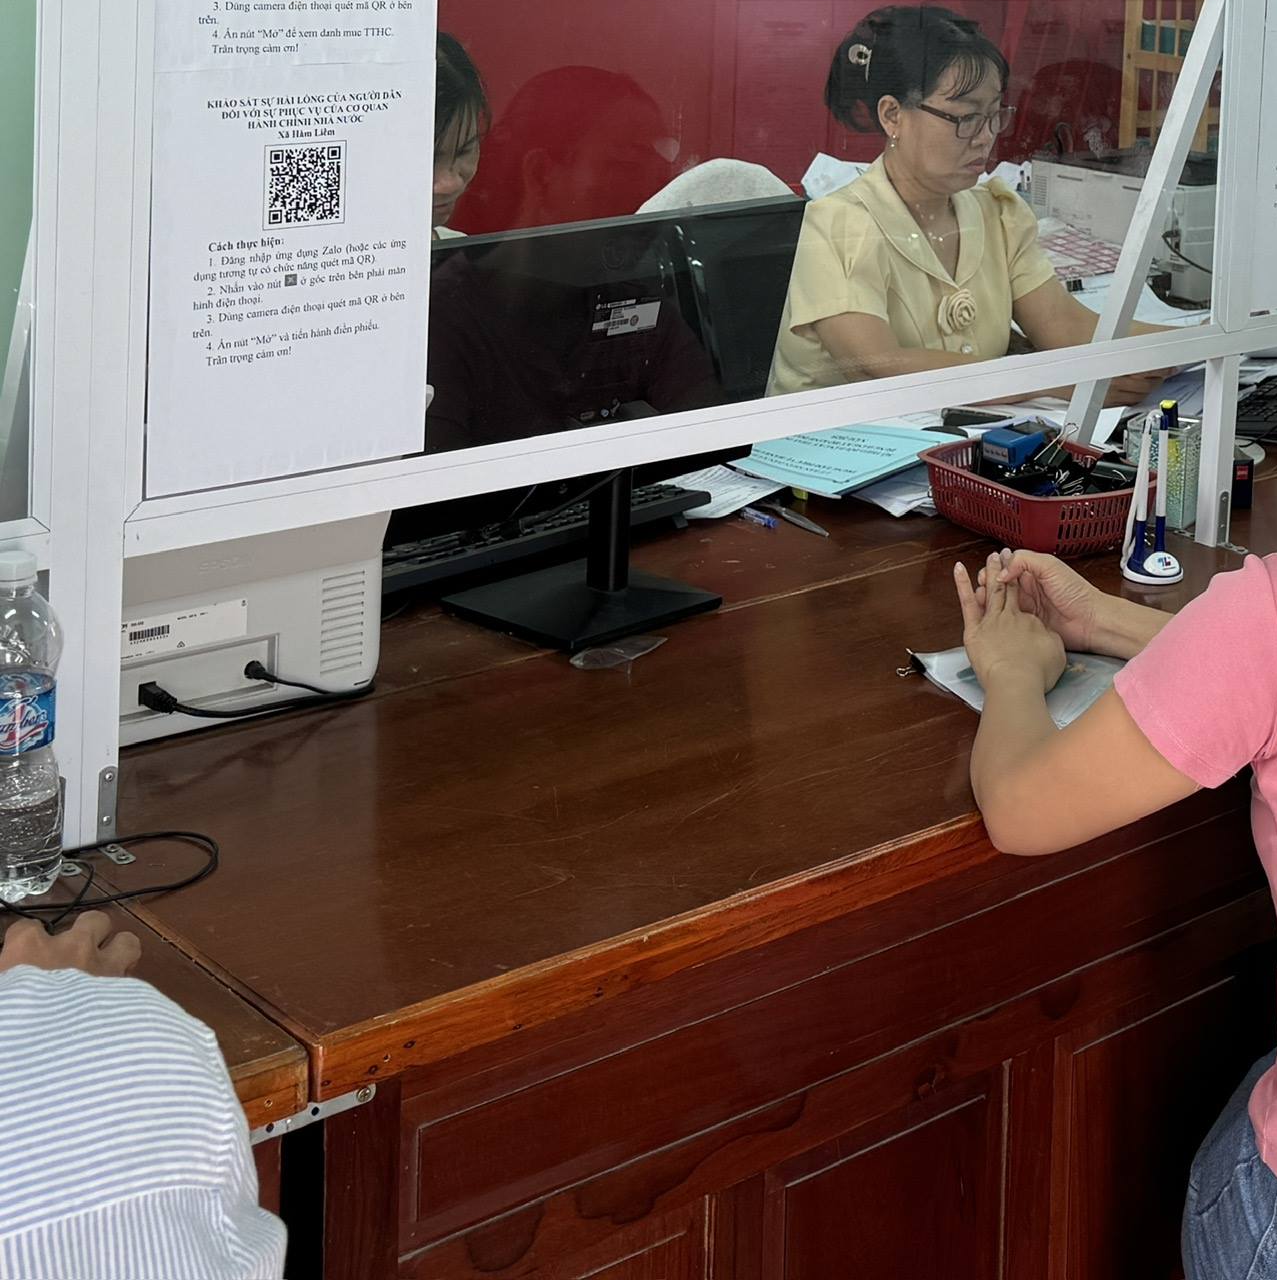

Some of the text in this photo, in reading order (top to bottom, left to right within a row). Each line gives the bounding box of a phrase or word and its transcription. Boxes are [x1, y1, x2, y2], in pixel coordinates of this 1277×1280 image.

[208, 97, 237, 109] KHẢO
[240, 97, 258, 107] SÁT
[261, 97, 275, 108] SỰ
[277, 94, 294, 105] HÀI
[327, 93, 347, 103] CỦA
[349, 91, 380, 102] NGƯỜI
[383, 89, 401, 99] DÂN
[243, 107, 261, 118] VỚI
[264, 107, 277, 118] SỰ
[279, 107, 305, 118] PHỤC
[309, 106, 321, 116] VỤ
[324, 103, 345, 114] CỦA
[346, 104, 360, 113] CƠ
[362, 102, 388, 113] QUAN
[248, 114, 364, 130] HÀNH CHÍNH NHÀ NƯỚC
[278, 128, 335, 139] Xã Hàm Liêm
